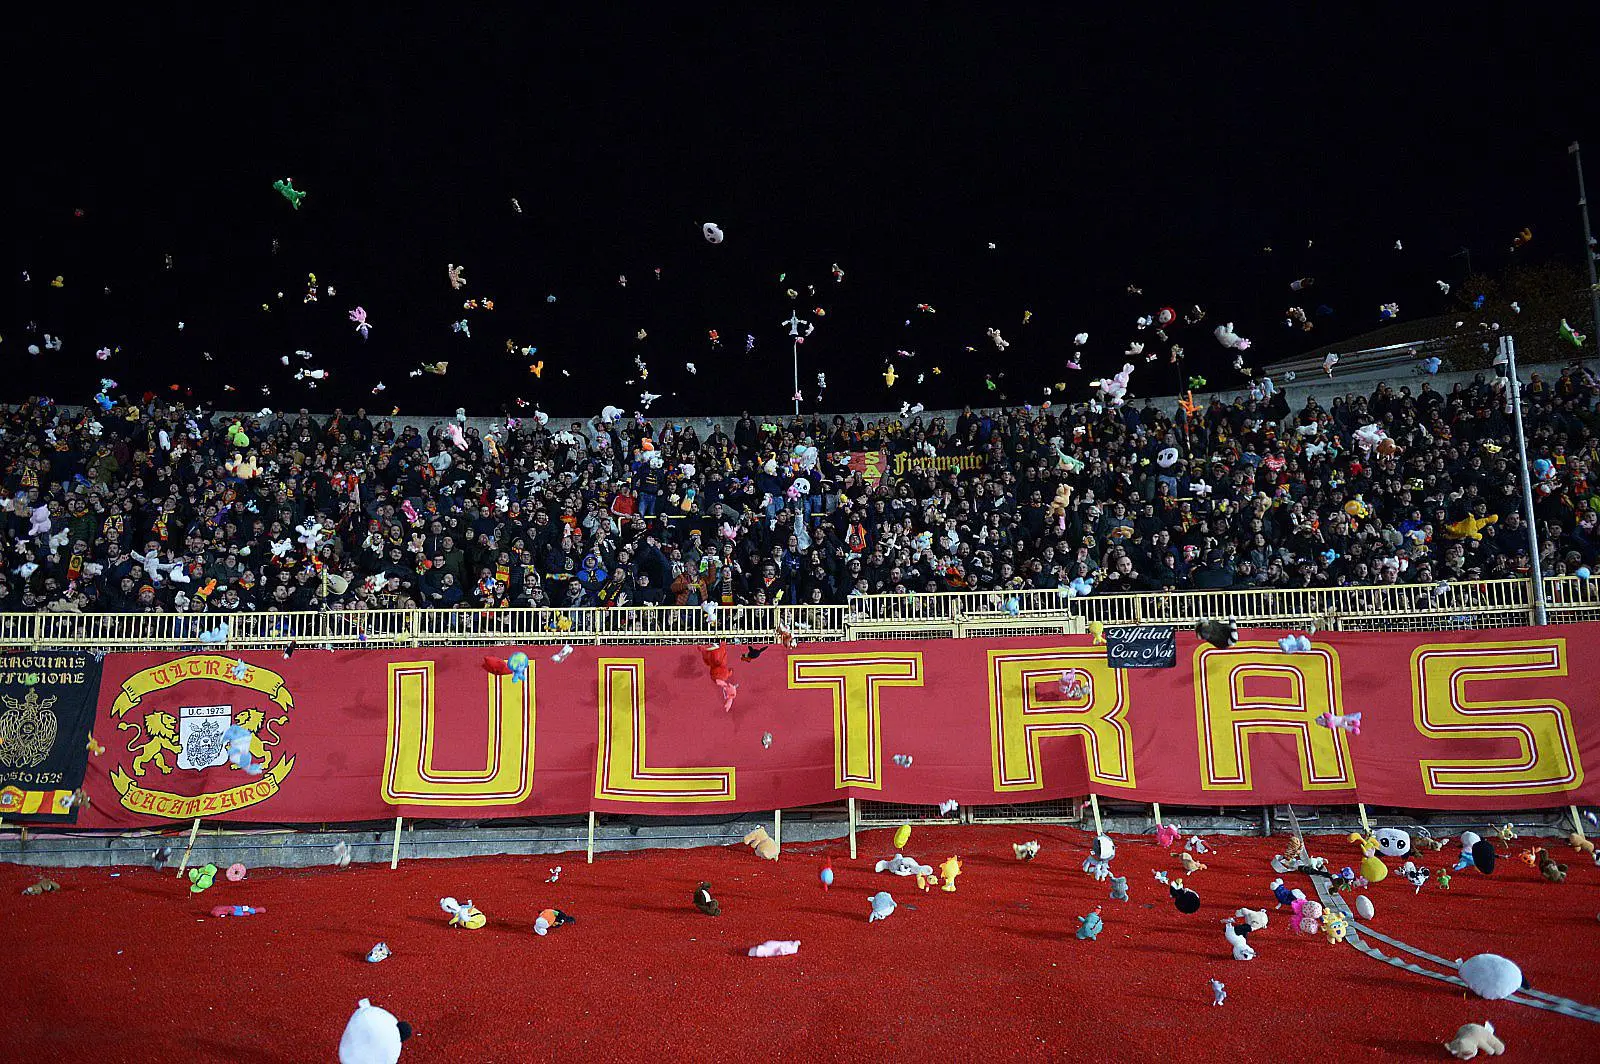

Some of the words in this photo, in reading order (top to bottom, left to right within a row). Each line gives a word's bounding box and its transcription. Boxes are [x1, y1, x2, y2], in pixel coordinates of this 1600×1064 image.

[1108, 626, 1174, 643] Diffidati
[1111, 644, 1139, 658] Con
[1142, 644, 1175, 659] Noi
[381, 637, 1584, 806] ULTRAS
[129, 781, 271, 815] CATANZARO
